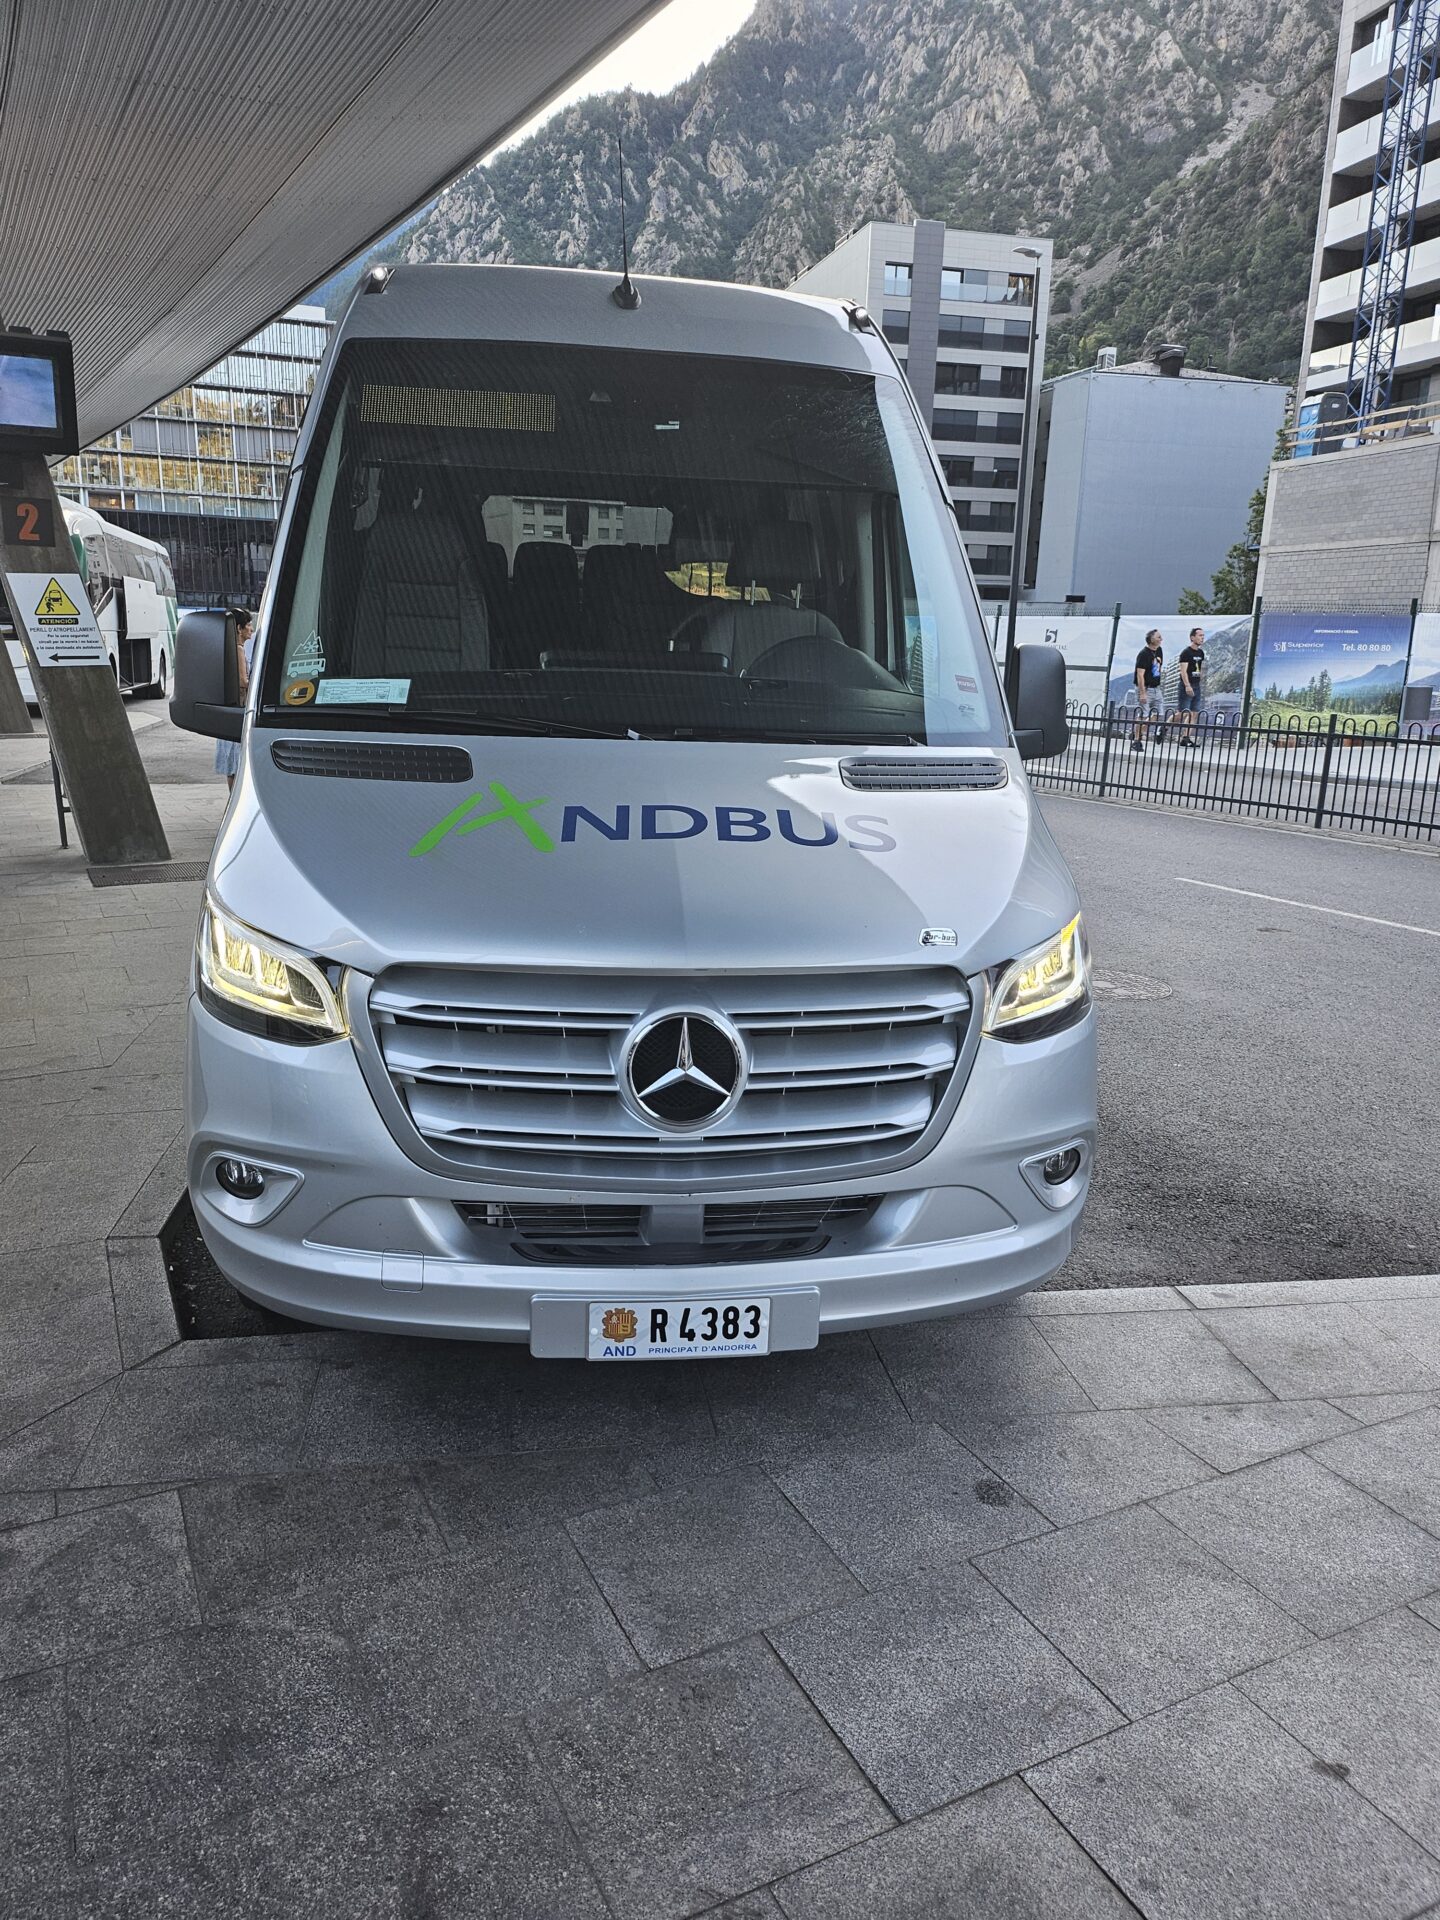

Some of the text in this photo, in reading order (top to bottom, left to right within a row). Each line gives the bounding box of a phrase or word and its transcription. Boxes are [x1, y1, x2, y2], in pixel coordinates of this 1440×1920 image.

[17, 502, 40, 541] 2
[1342, 643, 1391, 652] Tel. 80 80 80
[409, 781, 898, 858] ANDBUS
[650, 1304, 761, 1343] R 4383
[603, 1344, 758, 1357] AND PRINCIPAT D'ANDORRA
